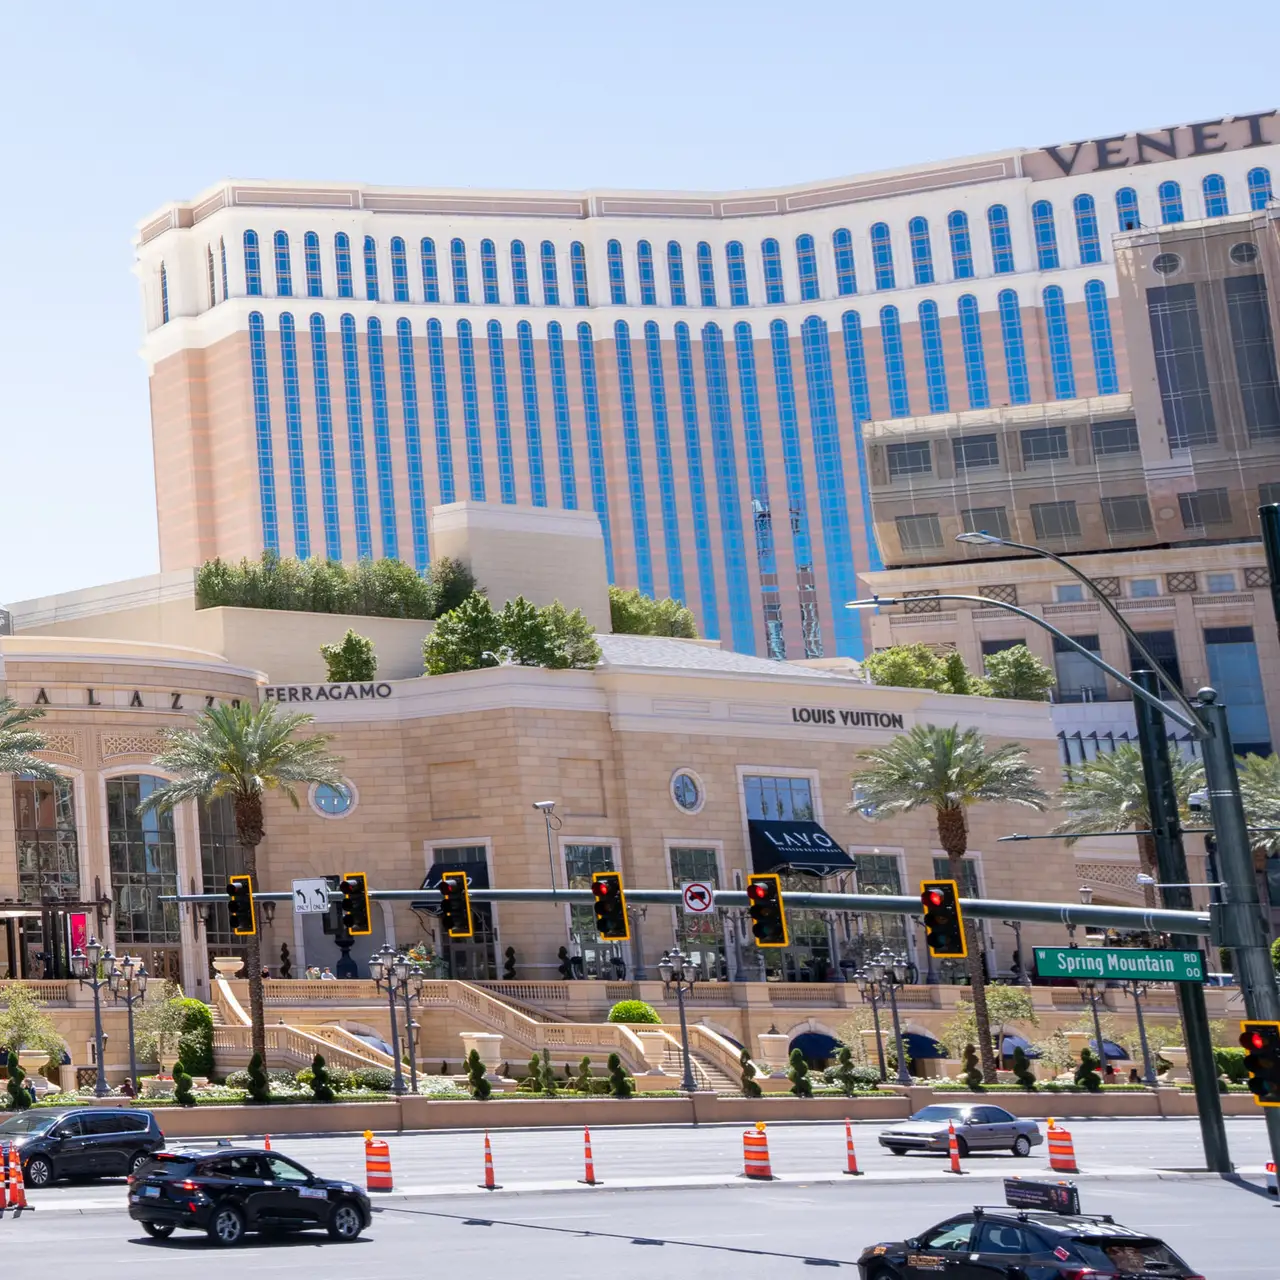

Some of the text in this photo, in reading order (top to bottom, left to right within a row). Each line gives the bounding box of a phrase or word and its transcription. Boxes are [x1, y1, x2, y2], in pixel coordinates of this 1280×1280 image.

[1039, 110, 1277, 176] VENET
[265, 683, 392, 702] FERRAGAMO
[792, 707, 904, 730] LOUIS VUITTON
[764, 831, 833, 847] LAVO
[1038, 951, 1198, 975] W Spring Mountain RD
